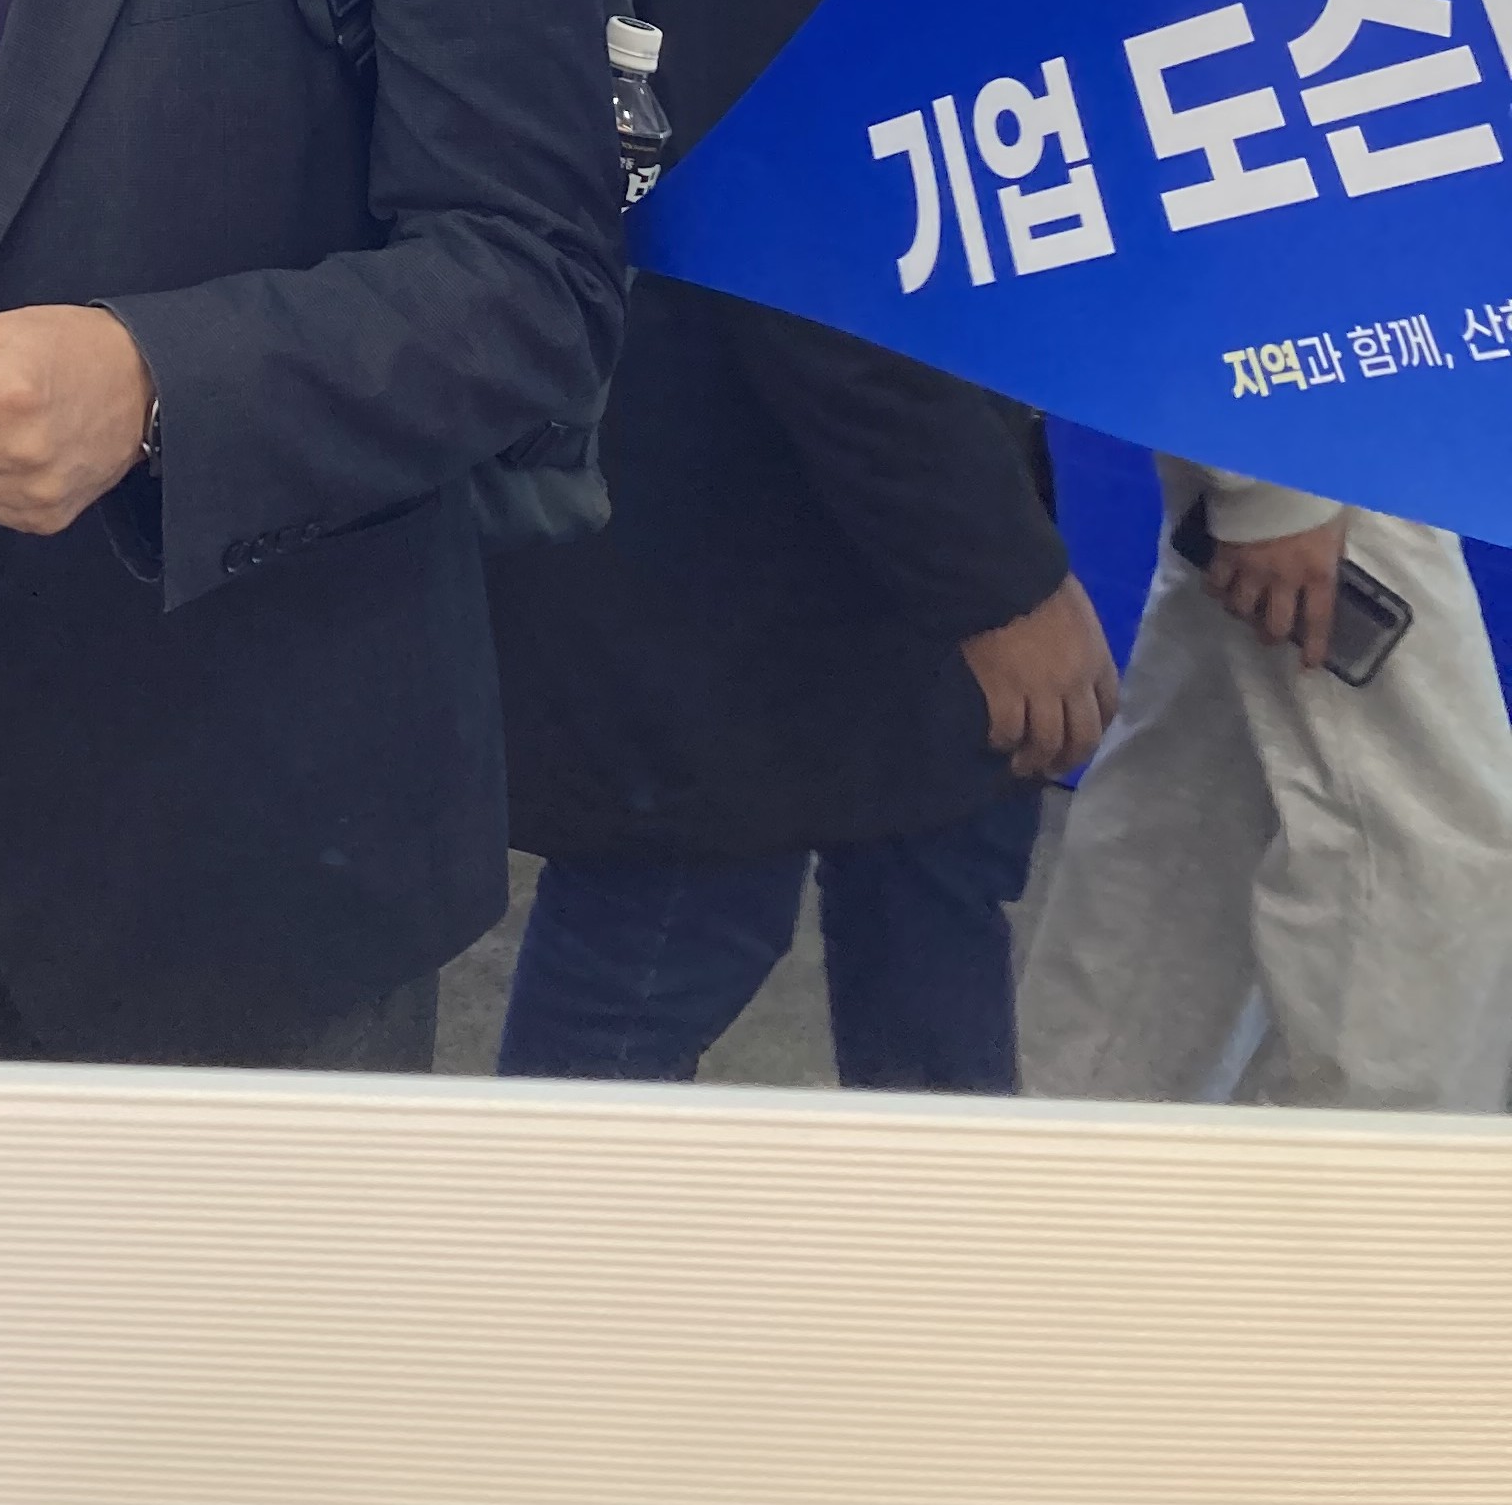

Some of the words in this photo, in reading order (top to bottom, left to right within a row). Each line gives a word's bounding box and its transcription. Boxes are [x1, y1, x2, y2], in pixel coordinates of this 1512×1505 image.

[867, 56, 1116, 294] 기업
[1223, 338, 1345, 398] 지역과
[1347, 312, 1455, 381] 함께,
[1461, 298, 1512, 362] 산
